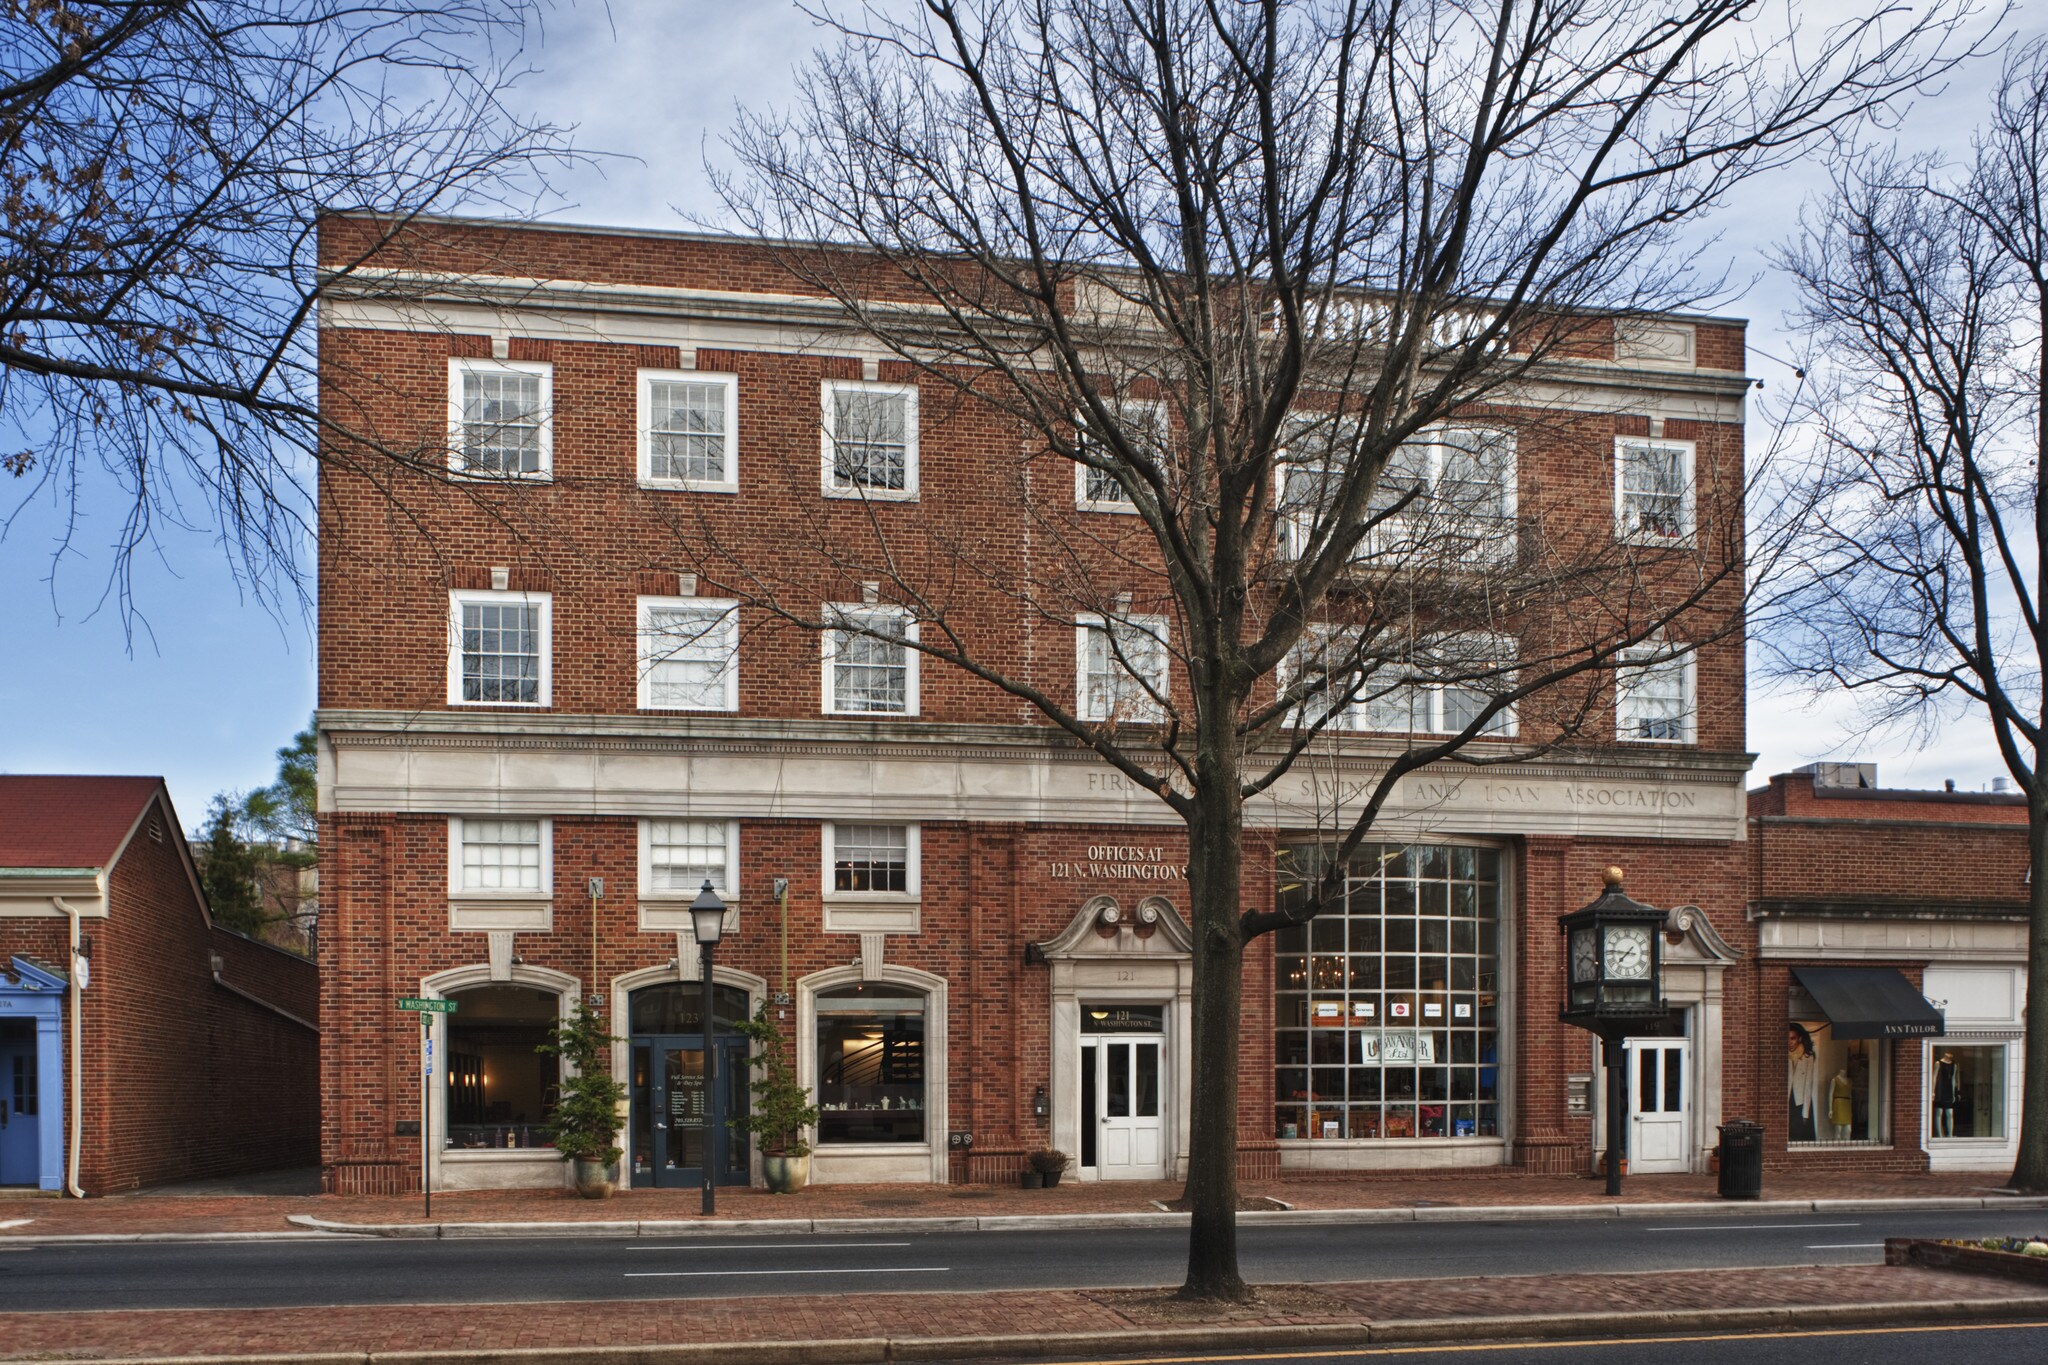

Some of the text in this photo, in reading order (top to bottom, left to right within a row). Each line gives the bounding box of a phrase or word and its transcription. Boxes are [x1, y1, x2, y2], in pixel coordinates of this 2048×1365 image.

[1088, 773, 1696, 808] FIRS SAVING AND LOAN ASSOCIATION
[1088, 845, 1164, 862] OFFICES AT
[1051, 862, 1070, 877] 121
[1073, 863, 1086, 878] N.
[1089, 864, 1179, 879] WASHINGTON
[1117, 970, 1134, 981] 121
[405, 1001, 446, 1012] WASHINGTON
[448, 1002, 457, 1012] ST
[680, 1012, 699, 1024] 123
[1116, 1010, 1130, 1021] 121
[1100, 1020, 1143, 1028] WASHINGTON
